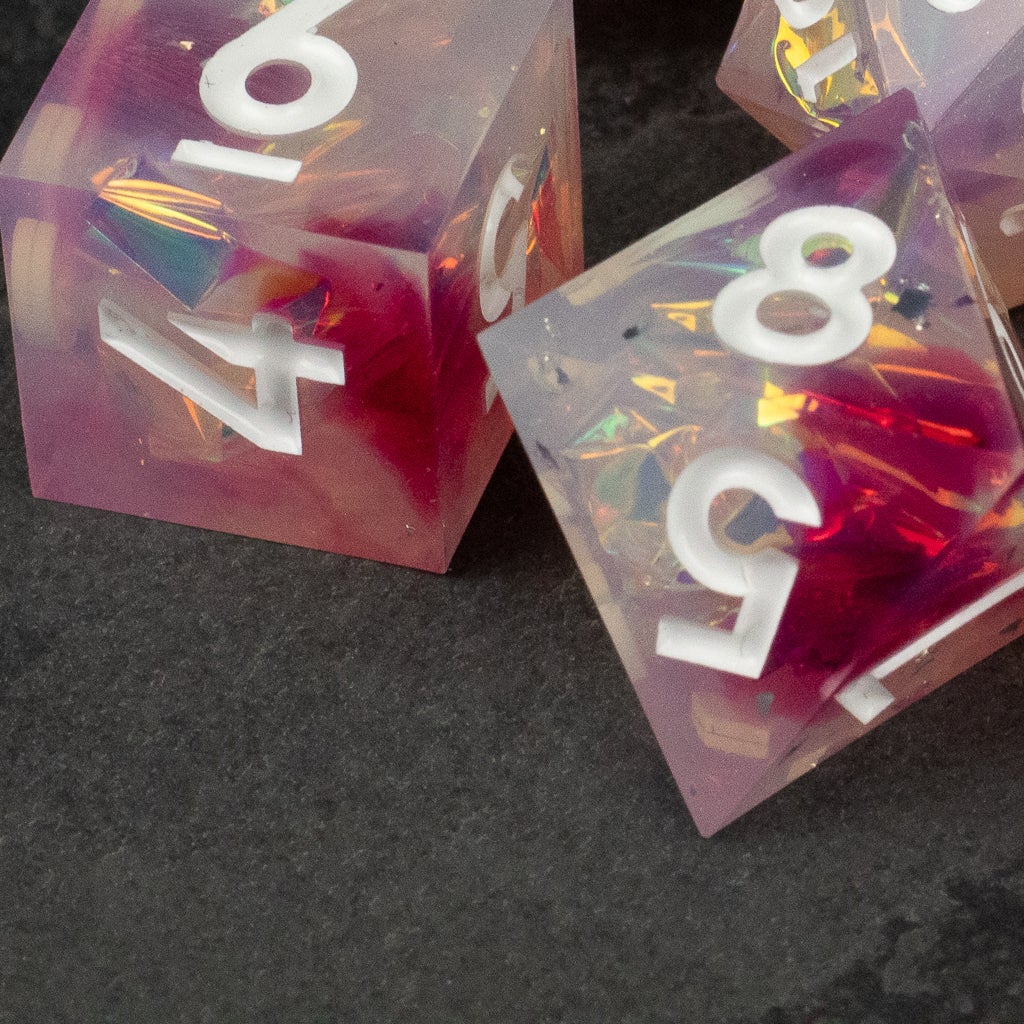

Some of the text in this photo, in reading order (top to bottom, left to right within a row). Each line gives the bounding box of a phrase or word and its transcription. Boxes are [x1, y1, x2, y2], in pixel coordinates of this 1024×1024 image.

[712, 204, 897, 366] 8
[98, 297, 346, 456] 4
[655, 448, 823, 679] 5
